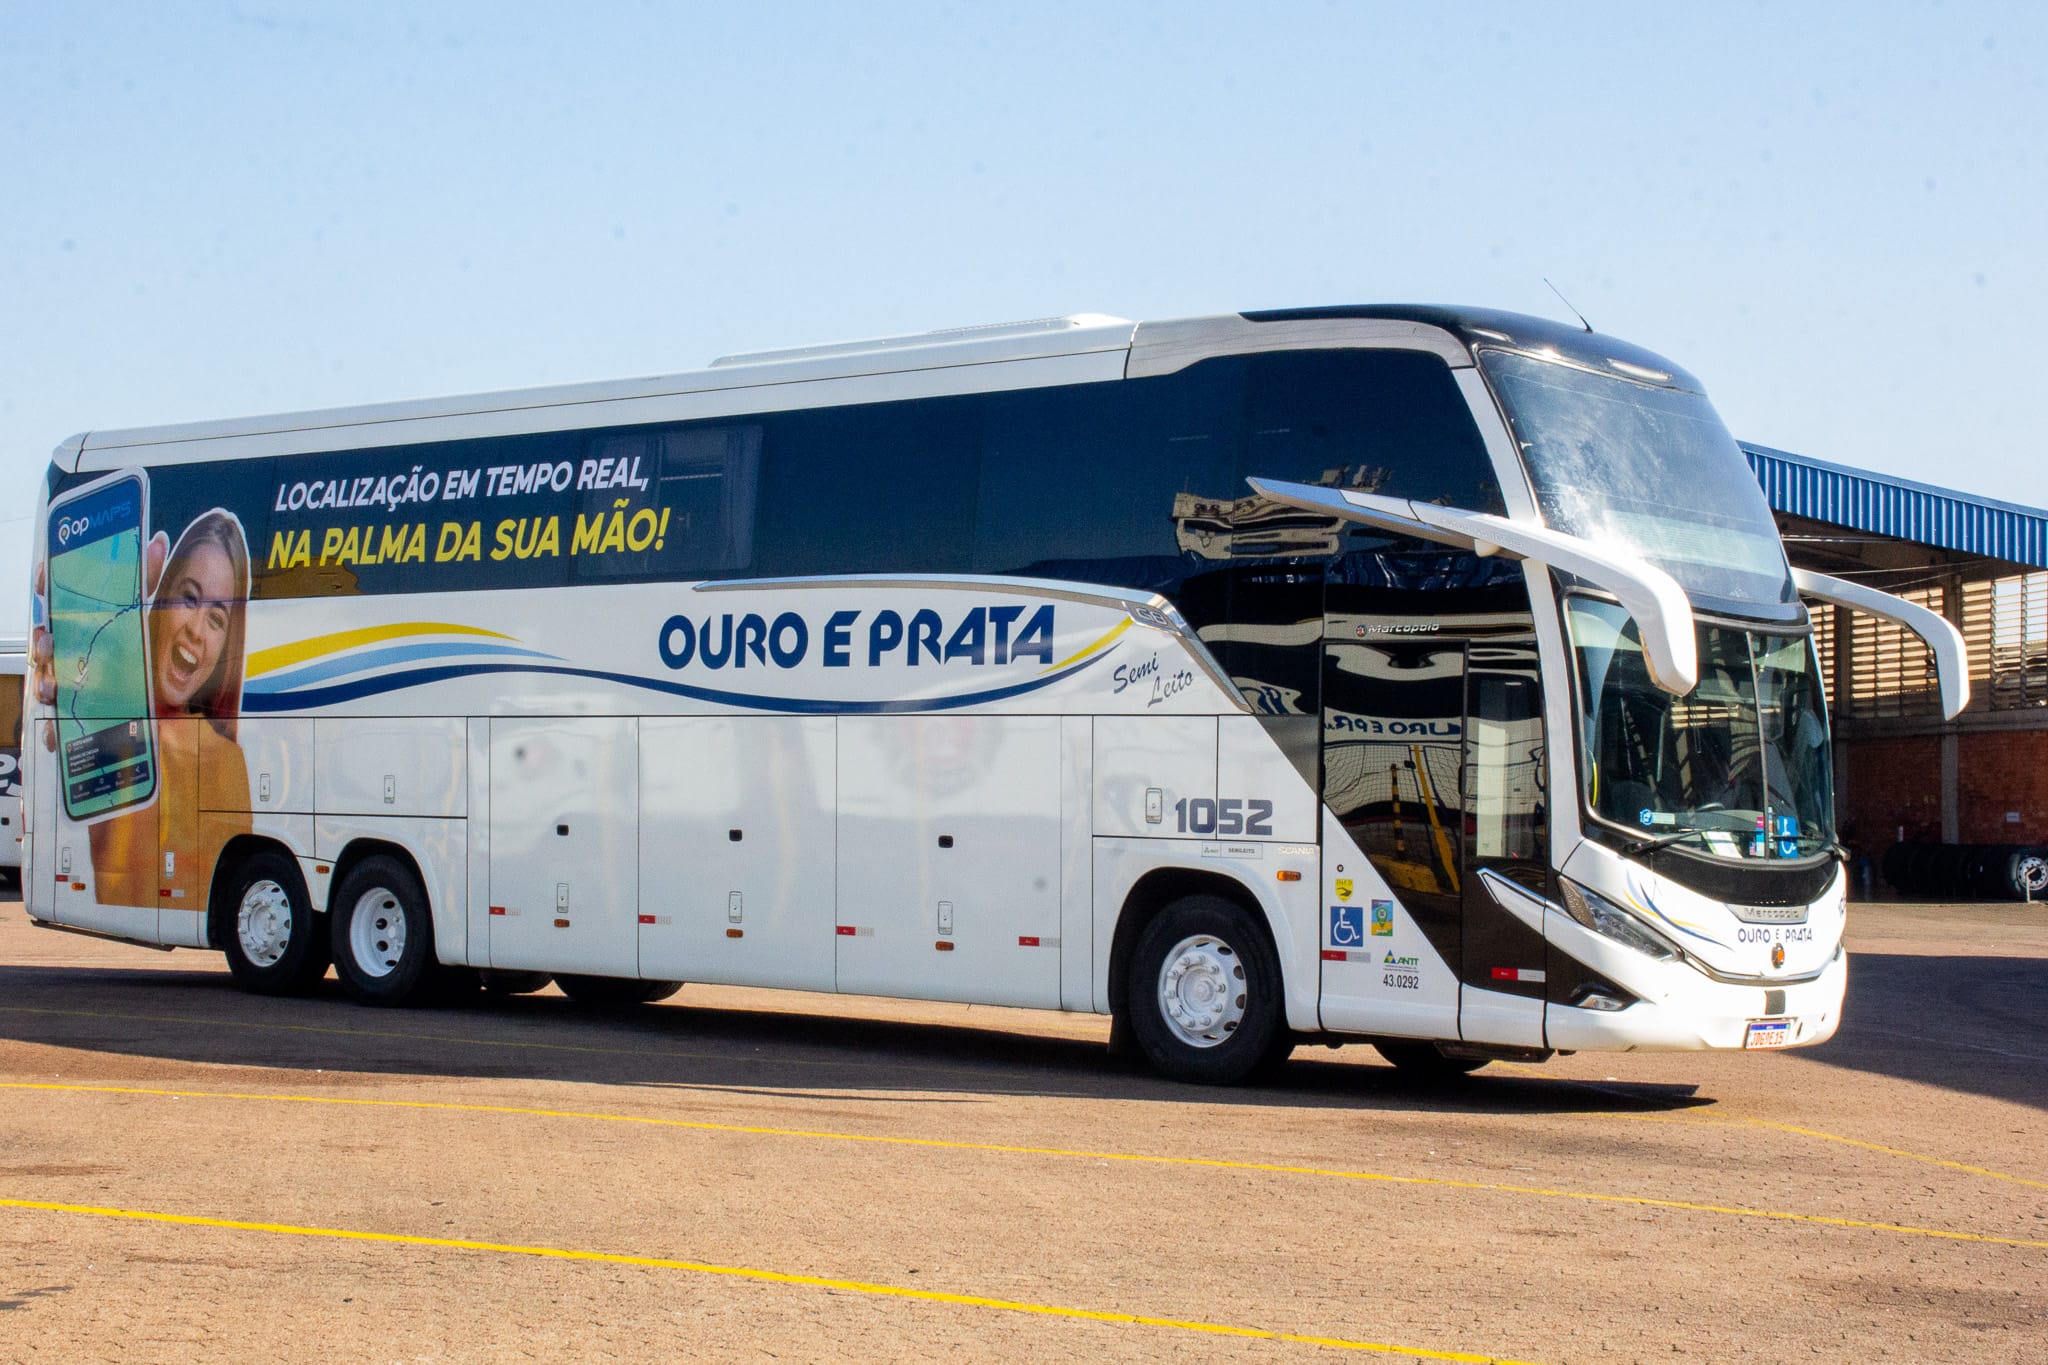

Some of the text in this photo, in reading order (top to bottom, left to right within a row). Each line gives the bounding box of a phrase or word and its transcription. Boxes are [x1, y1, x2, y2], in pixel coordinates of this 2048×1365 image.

[275, 456, 649, 512] LOCALIZAÇÃO EM TEMPO REAL,
[267, 498, 671, 569] NA PALMA DA SUA MÃO!
[658, 604, 1055, 671] OURO E PRATA
[1368, 623, 1440, 633] Marcopolo
[1113, 652, 1159, 694] Semi
[1147, 669, 1193, 708] Leito
[1175, 798, 1273, 836] 1052
[1279, 846, 1315, 855] SCANIA
[1738, 928, 1771, 943] OURO
[1785, 928, 1813, 942] PRATA
[1397, 957, 1419, 966] ANTT
[1382, 974, 1419, 989] 43.0292
